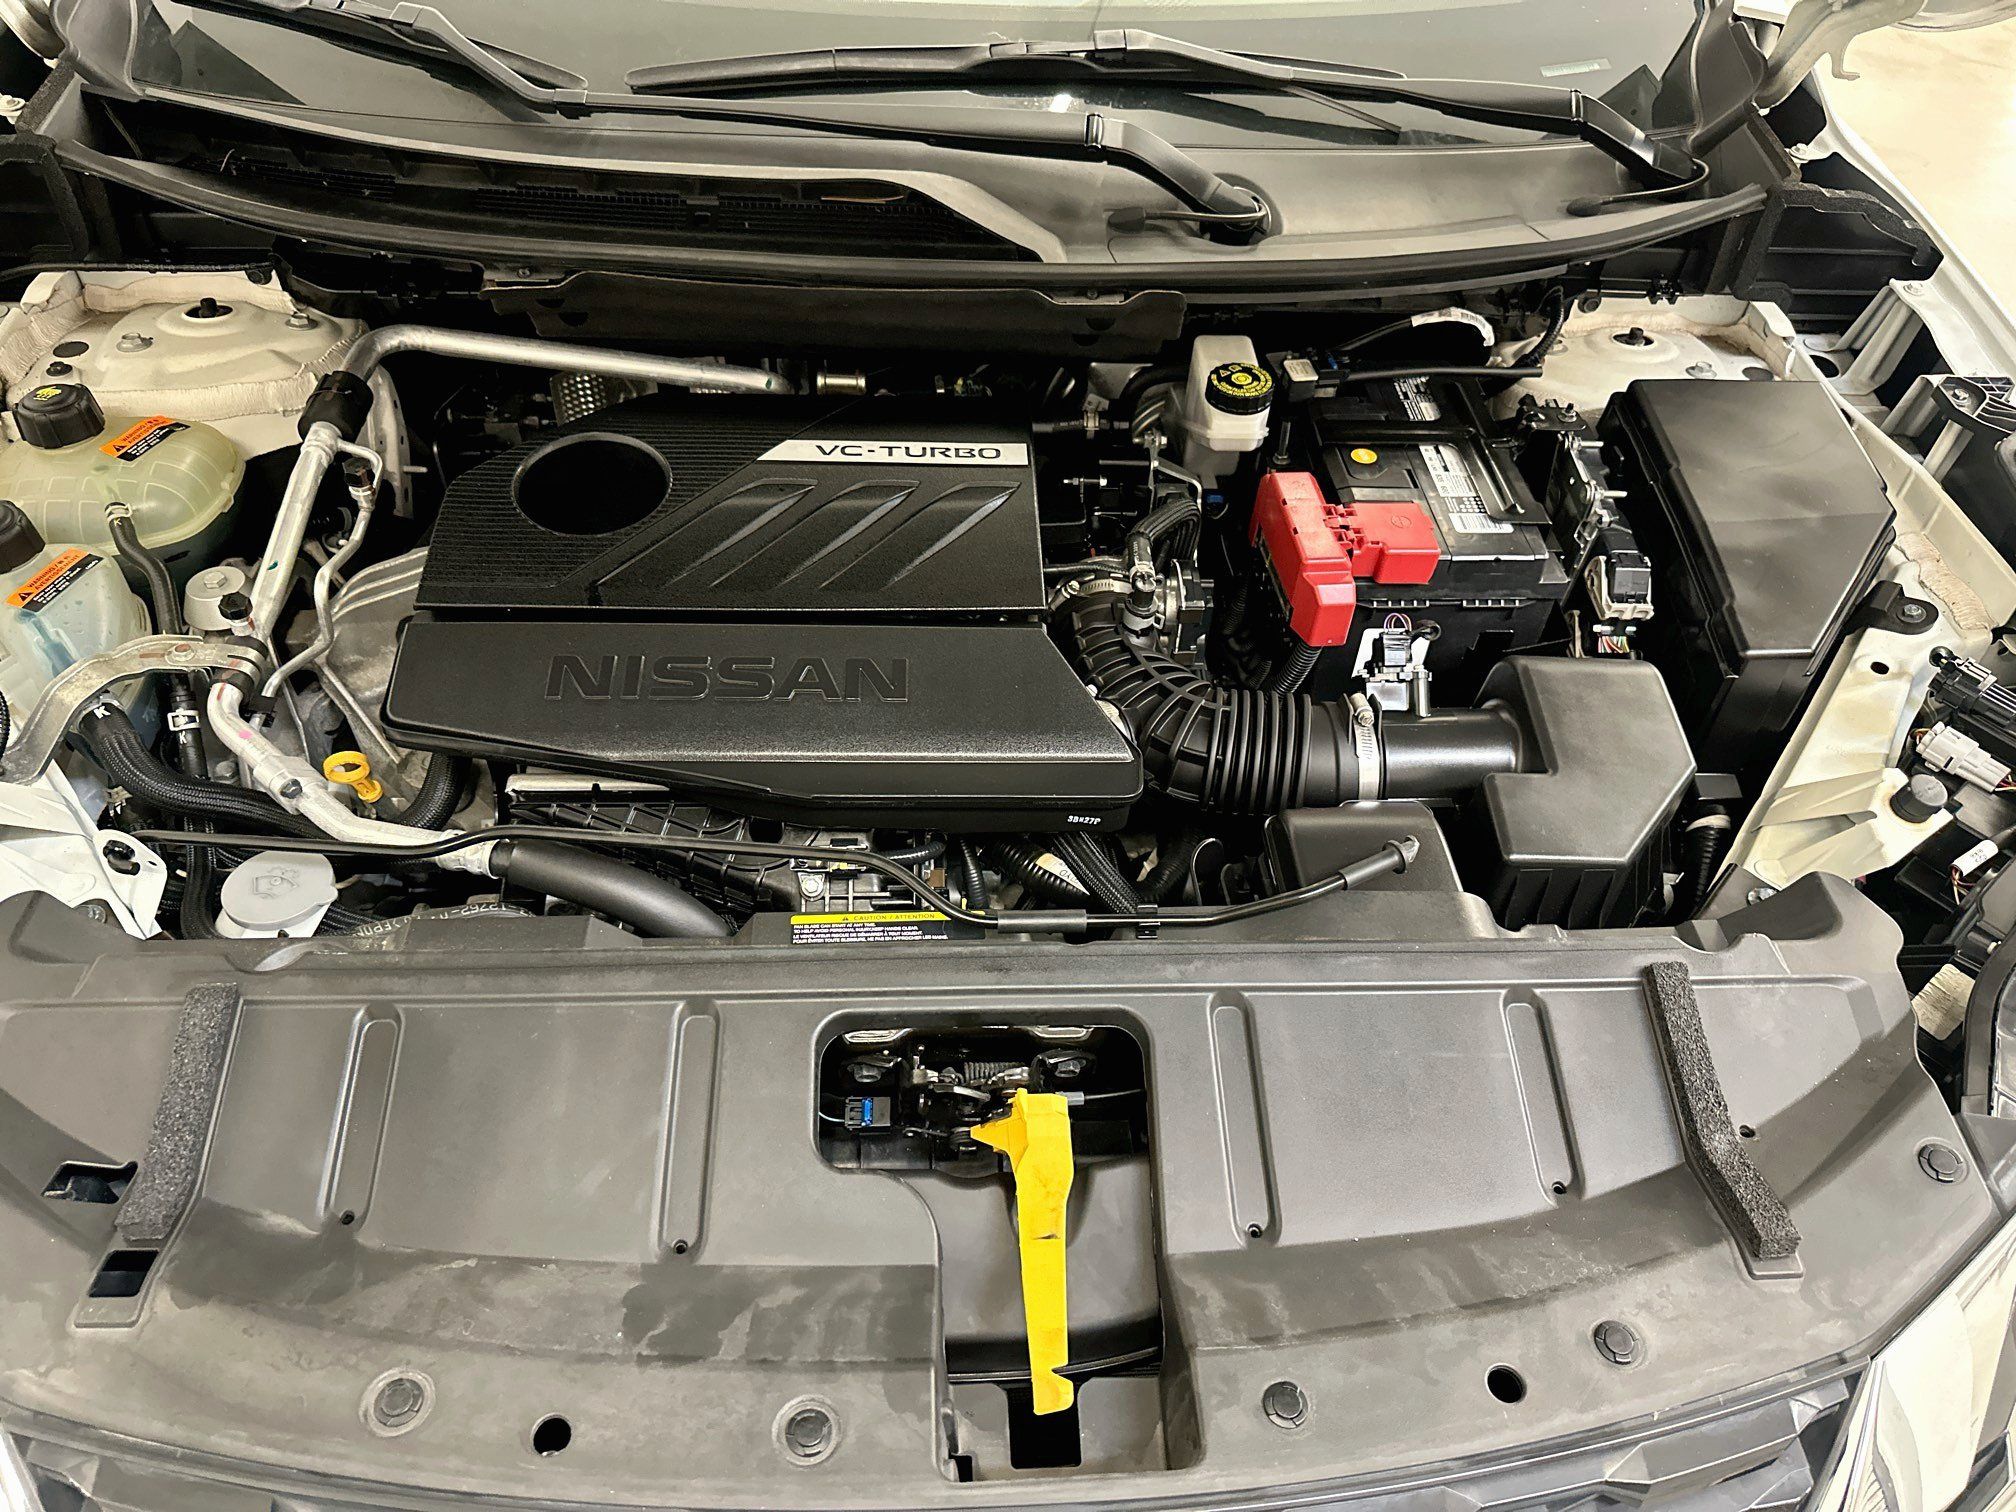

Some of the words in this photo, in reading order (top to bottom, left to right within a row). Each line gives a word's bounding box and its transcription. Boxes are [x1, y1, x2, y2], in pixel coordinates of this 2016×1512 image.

[815, 445, 1001, 459] VC-TURBO
[545, 655, 908, 702] NISSAN
[93, 706, 111, 719] K
[179, 731, 188, 744] K
